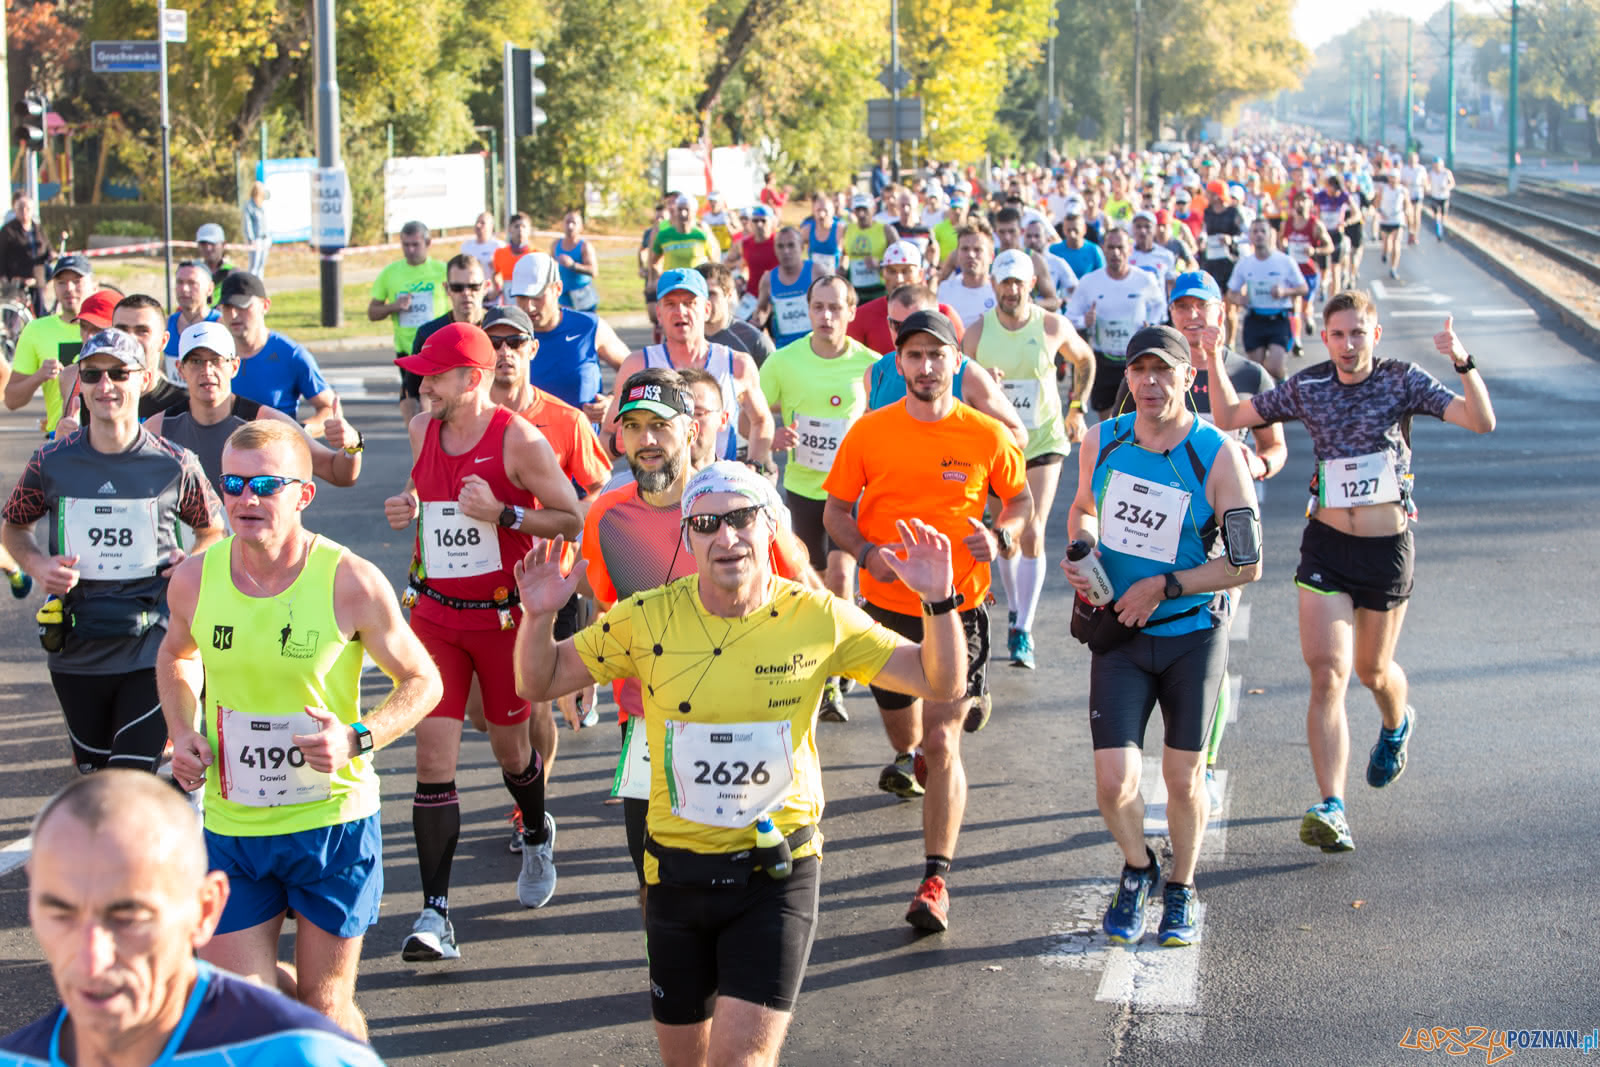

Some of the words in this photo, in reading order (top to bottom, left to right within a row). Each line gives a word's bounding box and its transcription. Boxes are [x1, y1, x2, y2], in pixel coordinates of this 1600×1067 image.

[802, 433, 837, 450] 2825
[1341, 478, 1379, 498] 1227
[1114, 501, 1167, 531] 2347
[88, 527, 133, 547] 958
[434, 527, 481, 547] 1668
[1124, 526, 1149, 538] Bernard
[768, 696, 801, 708] Janusz
[240, 745, 305, 769] 4190
[694, 760, 770, 785] 2626
